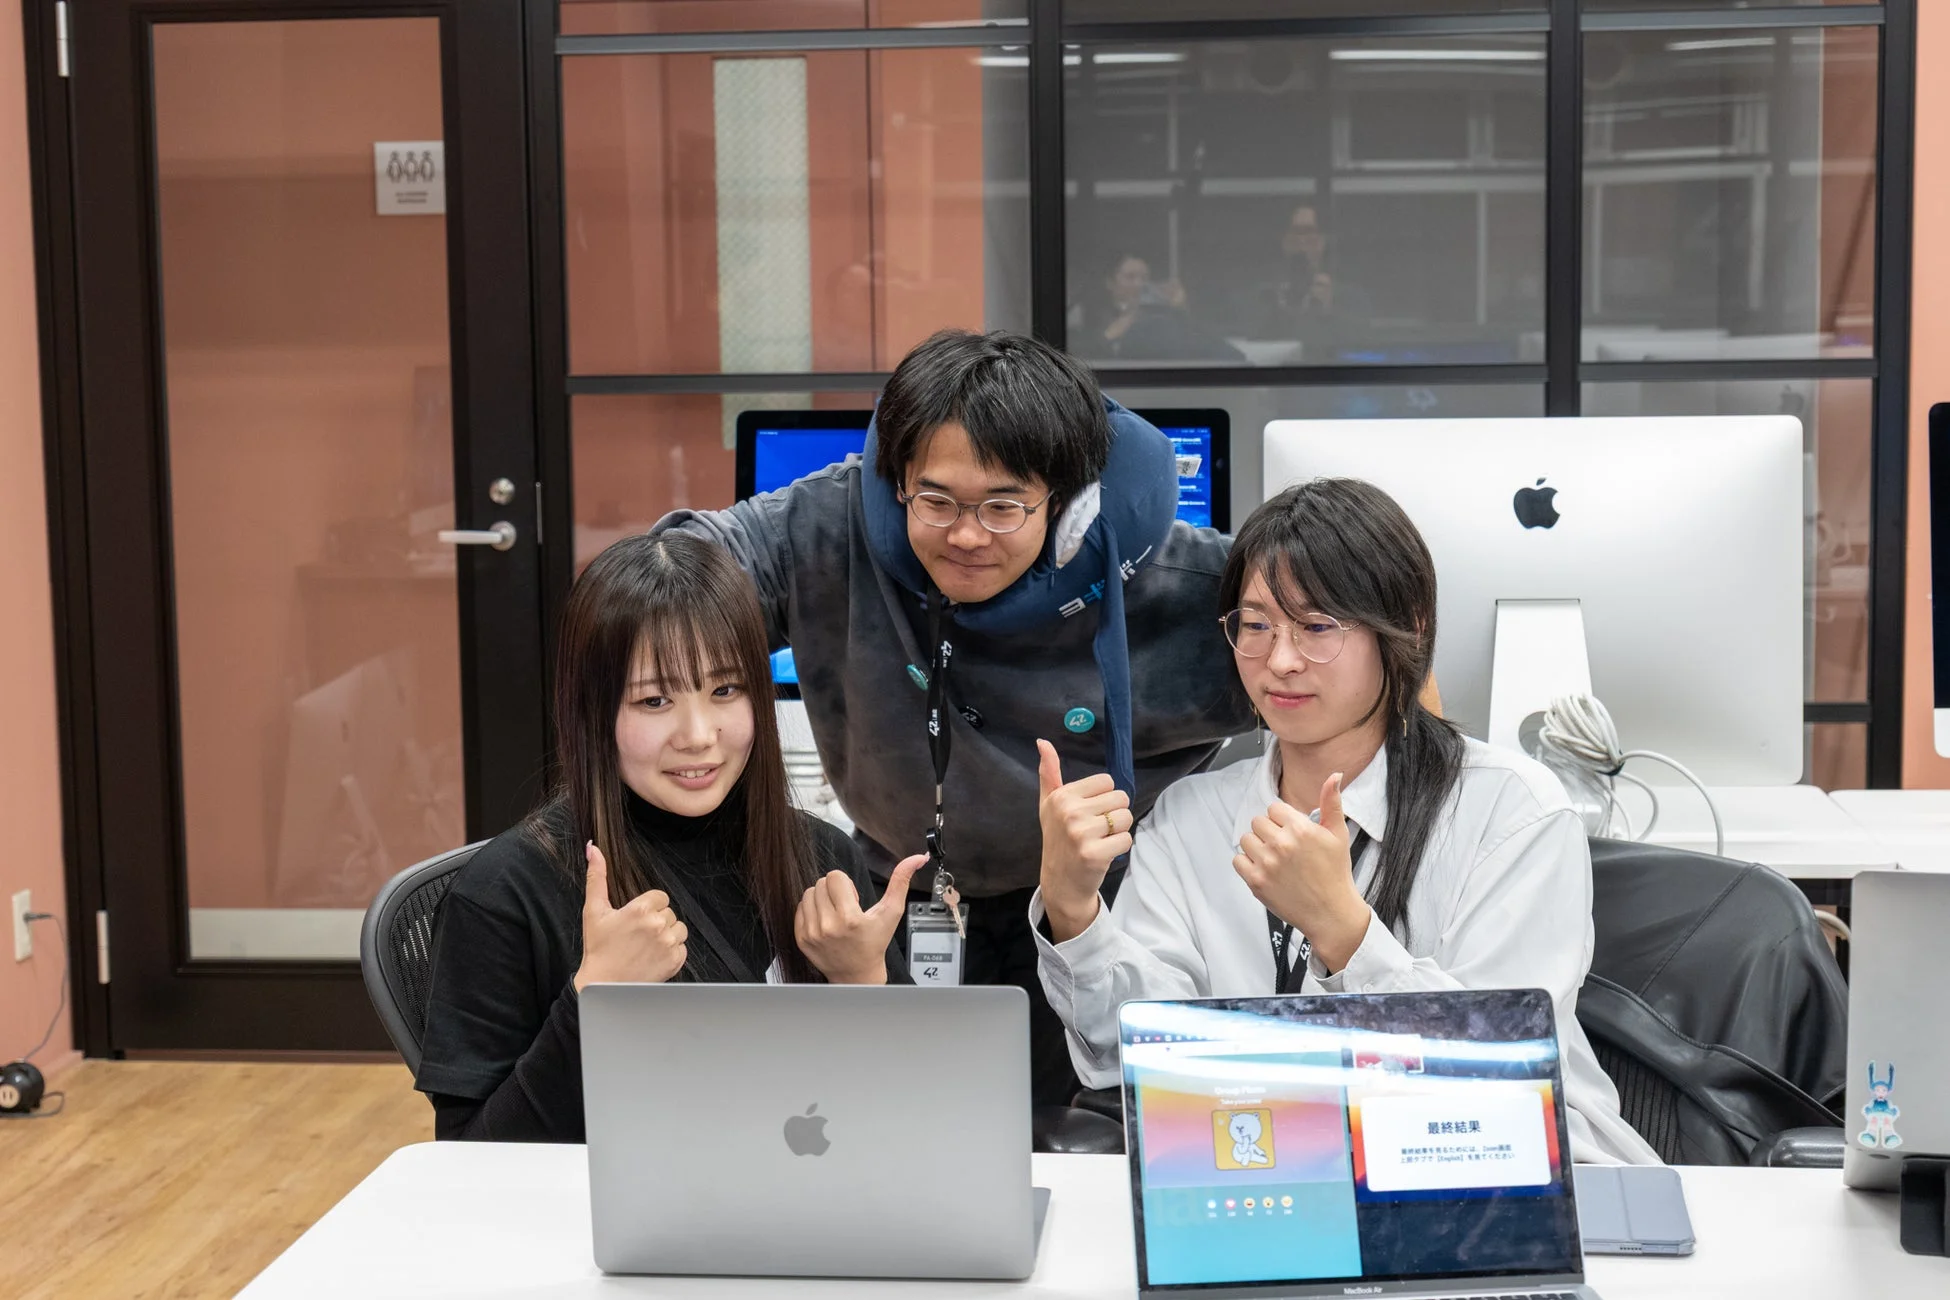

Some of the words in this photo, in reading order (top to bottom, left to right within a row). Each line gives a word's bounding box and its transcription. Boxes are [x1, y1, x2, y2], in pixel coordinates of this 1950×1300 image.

[923, 967, 938, 978] 42
[1427, 1120, 1481, 1134] 最終結果
